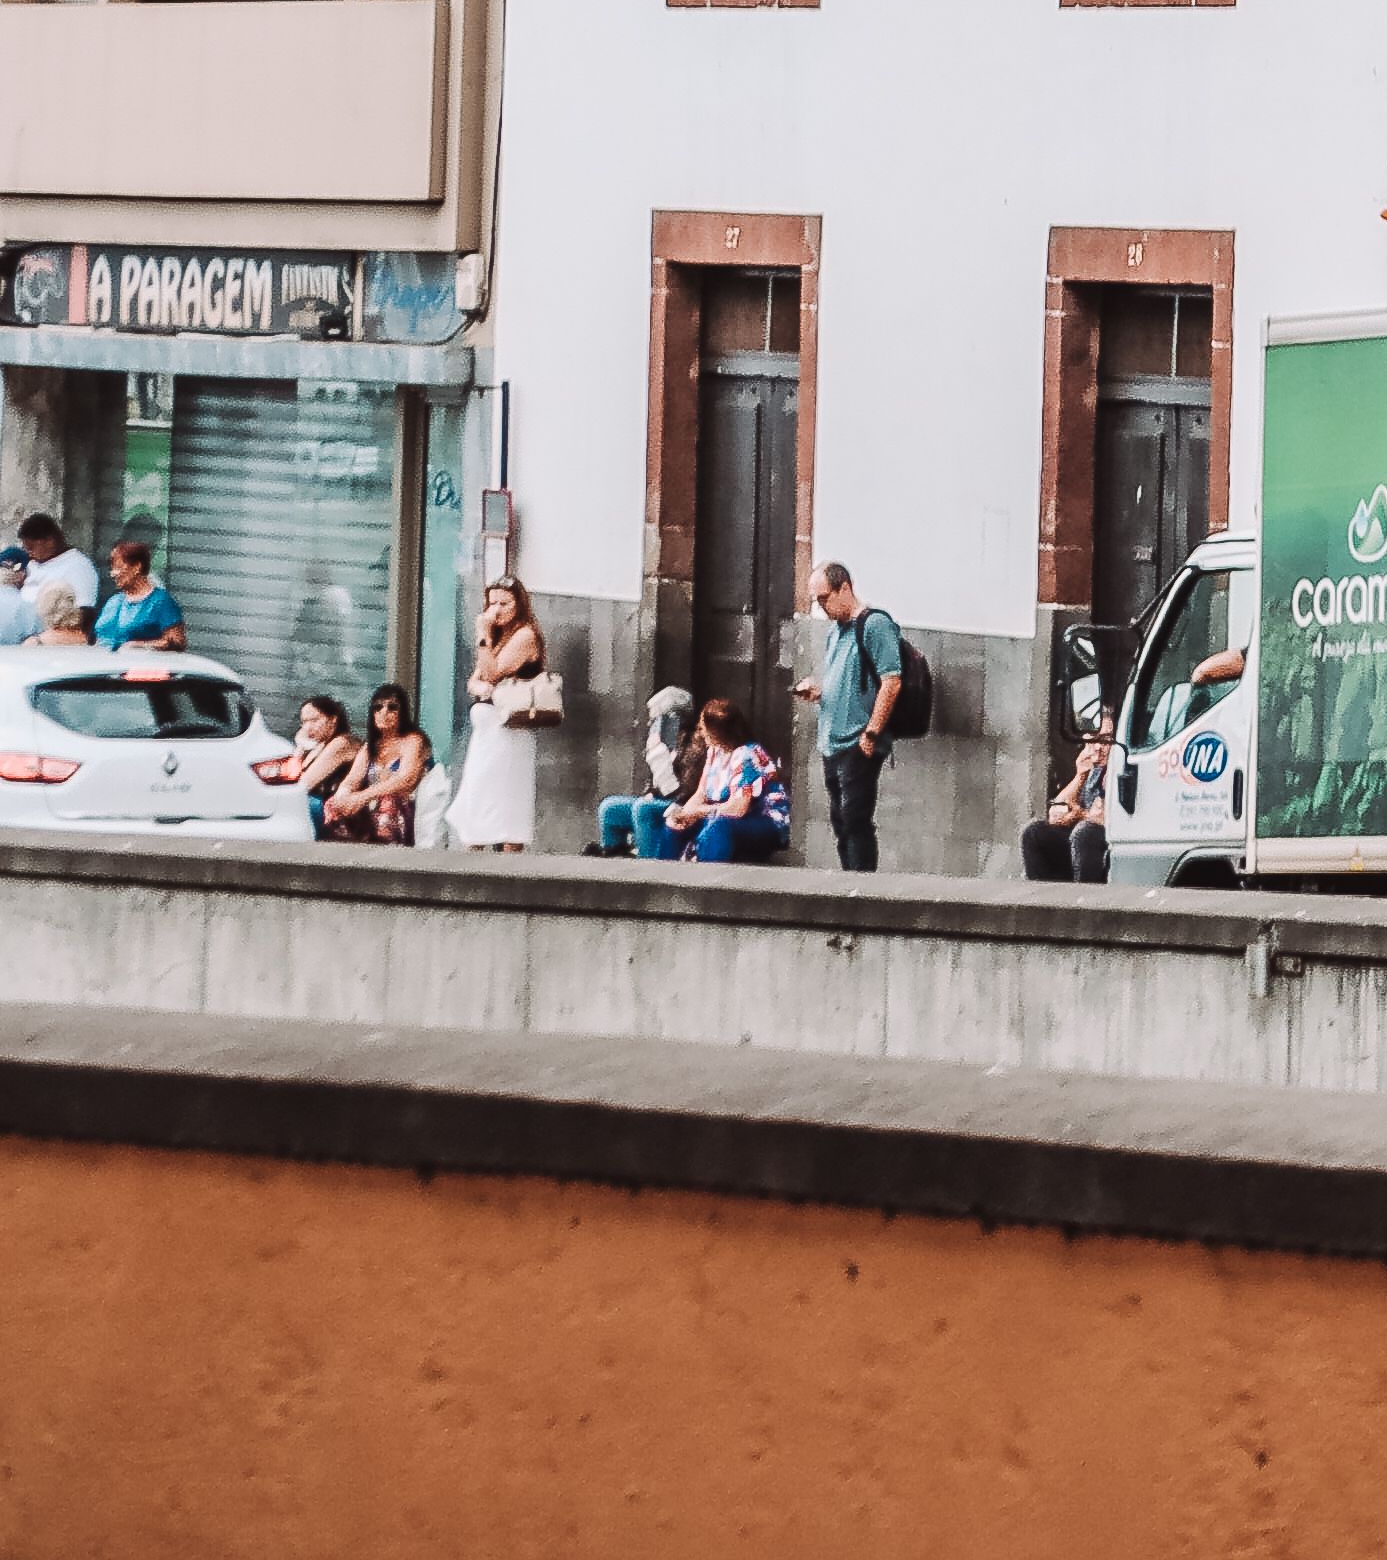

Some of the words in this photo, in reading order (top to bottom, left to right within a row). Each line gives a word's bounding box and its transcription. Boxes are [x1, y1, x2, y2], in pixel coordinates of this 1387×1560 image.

[89, 254, 112, 323] A
[119, 255, 272, 329] PARAGEM
[1185, 742, 1225, 774] JNA
